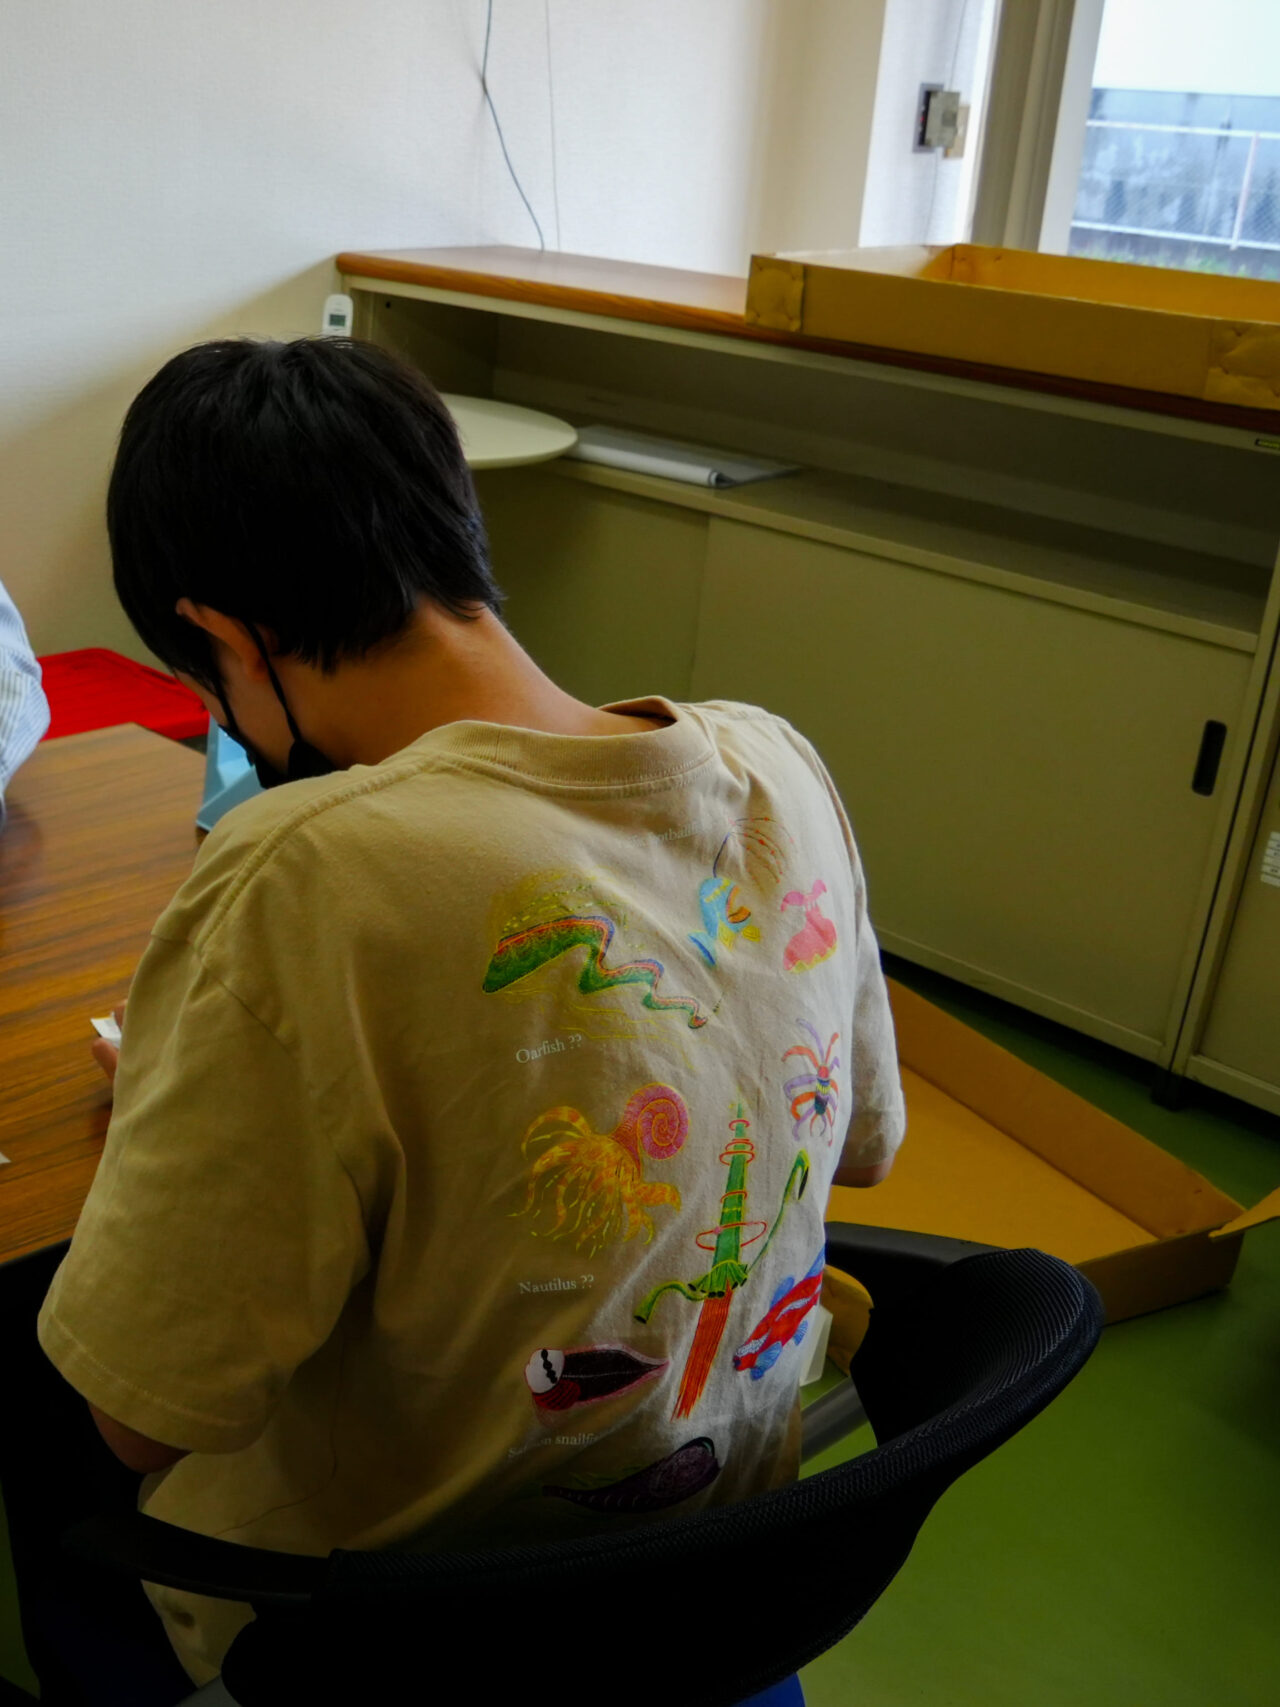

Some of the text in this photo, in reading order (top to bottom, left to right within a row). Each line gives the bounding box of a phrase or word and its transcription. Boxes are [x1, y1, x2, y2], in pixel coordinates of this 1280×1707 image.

[516, 1033, 582, 1063] Oarfish ??
[518, 1273, 595, 1294] Nautilus ??
